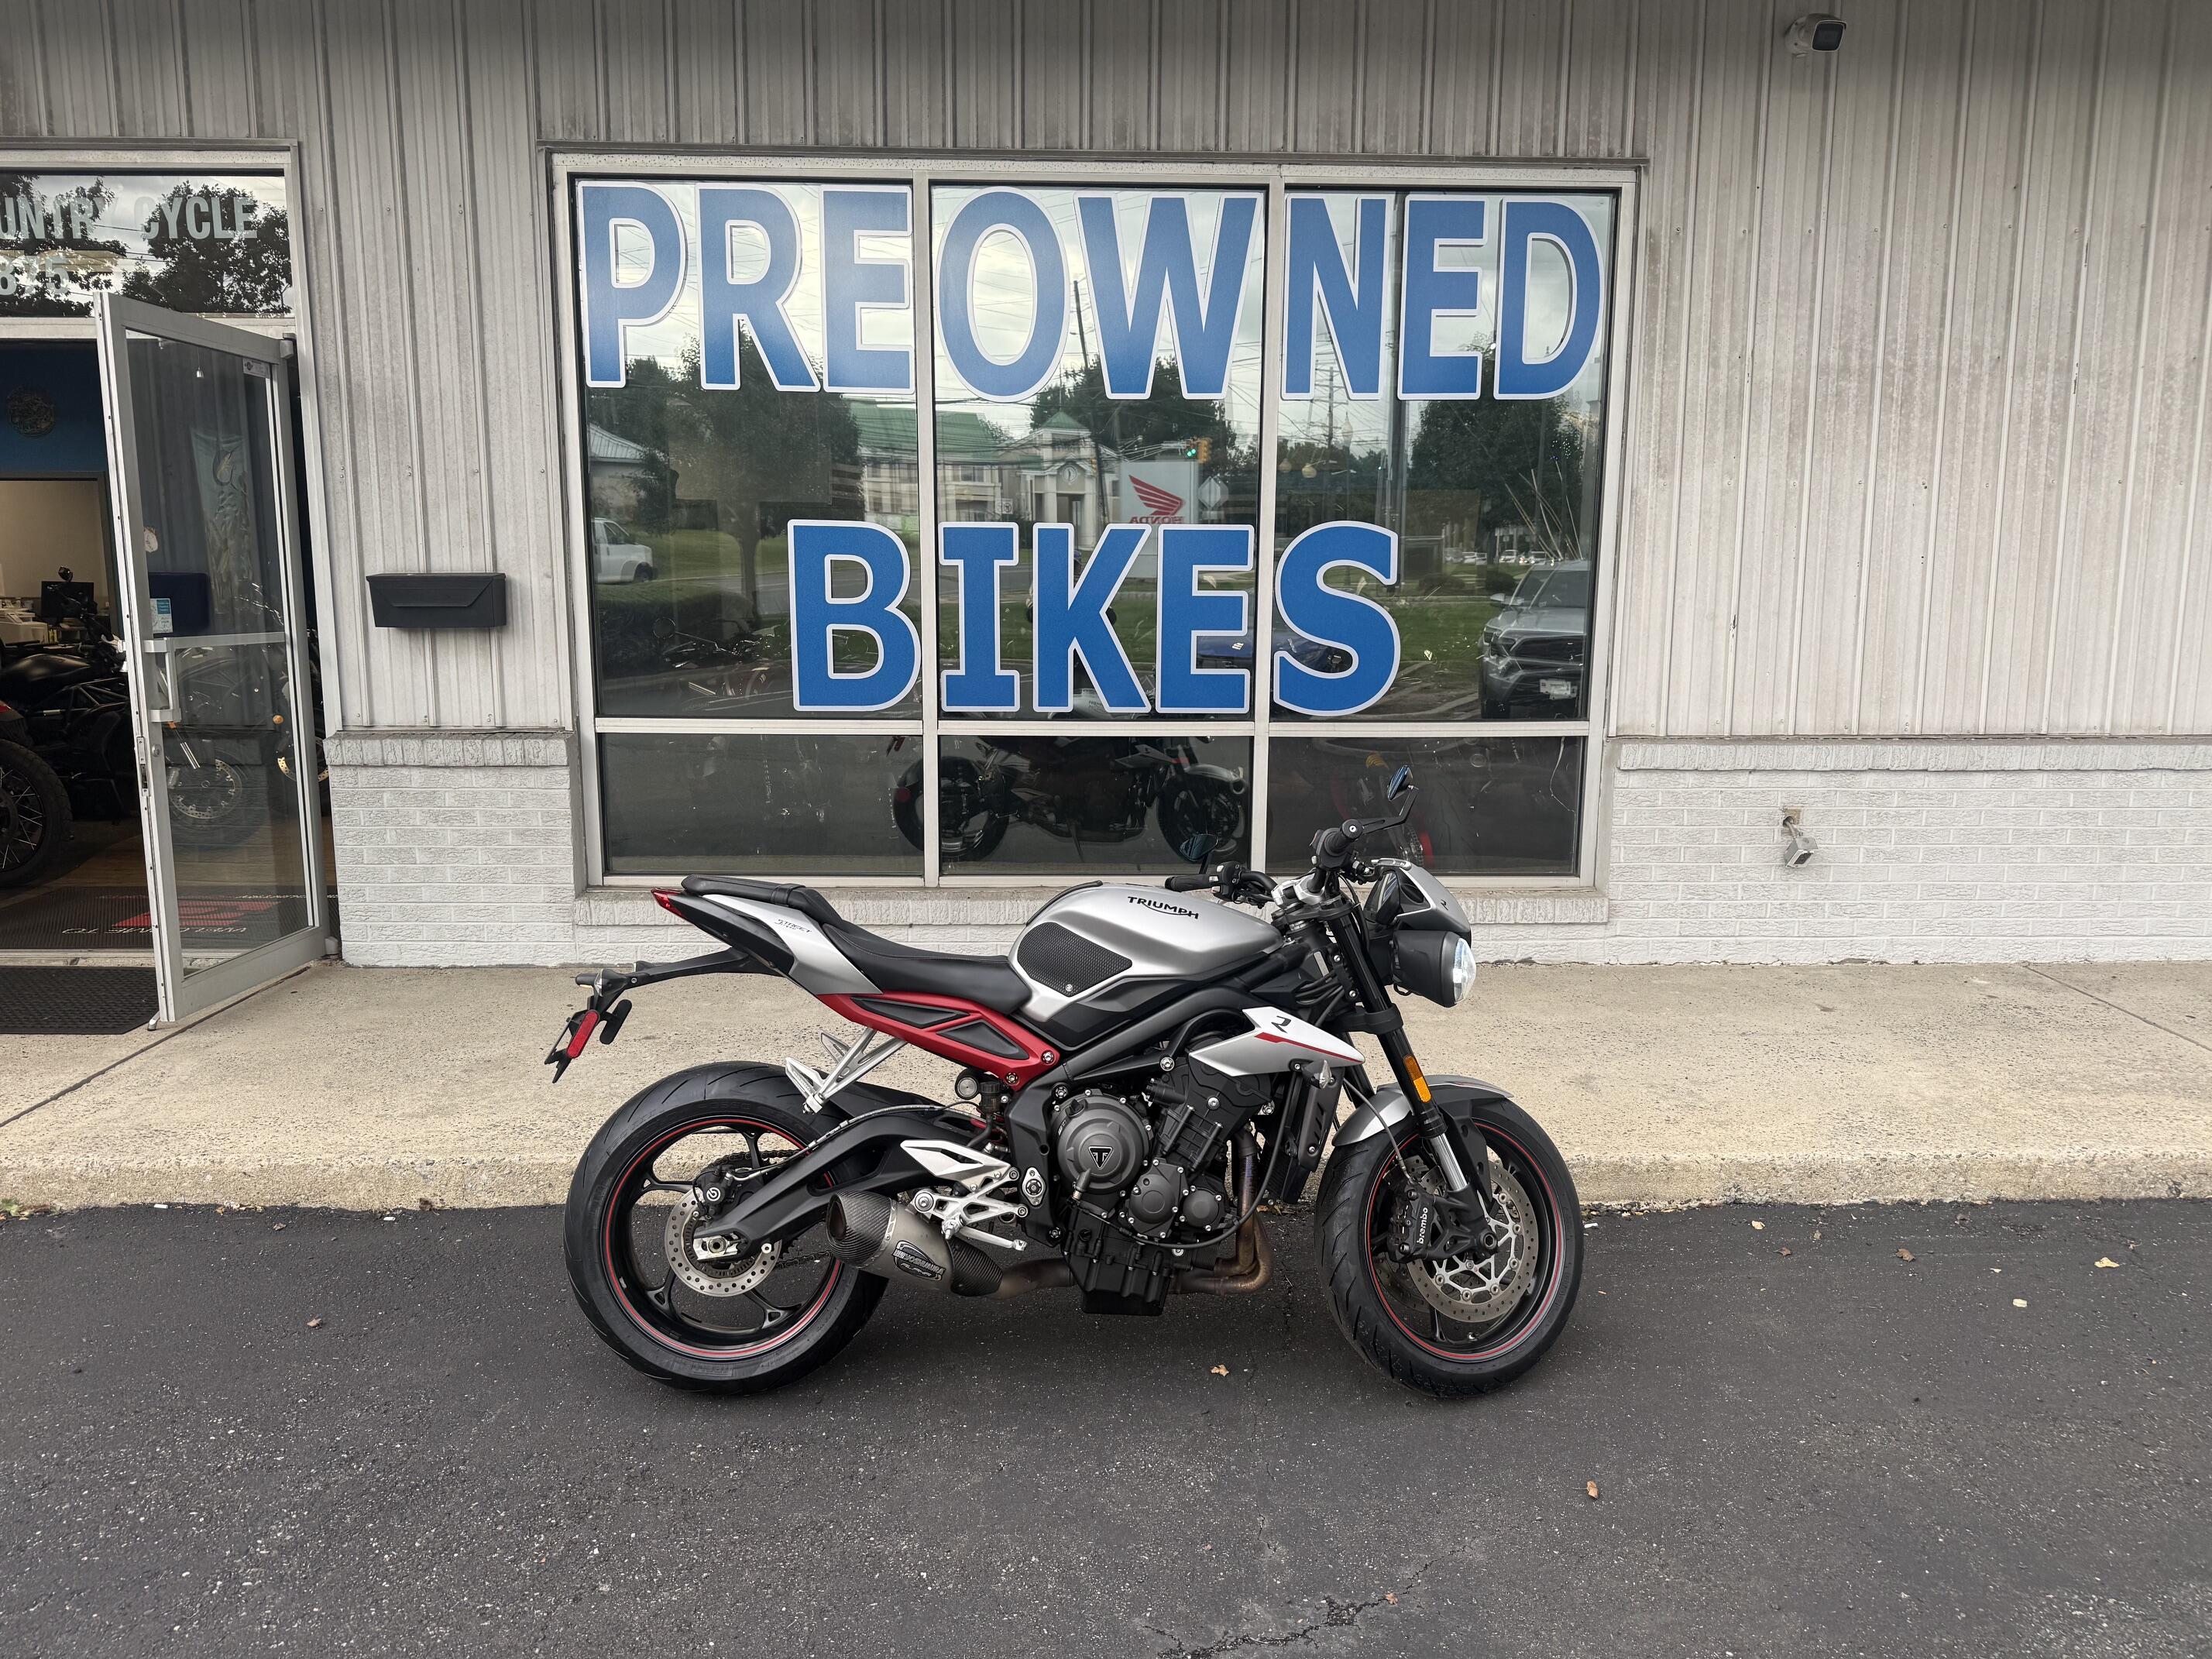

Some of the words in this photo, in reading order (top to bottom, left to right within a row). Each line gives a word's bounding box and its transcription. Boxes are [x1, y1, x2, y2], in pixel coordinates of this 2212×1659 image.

[134, 196, 258, 240] CYCLE
[576, 181, 1604, 402] PREOWNED
[788, 520, 1401, 716] BIKES
[1127, 896, 1199, 919] TRIUMPH
[1417, 1207, 1428, 1245] brembo
